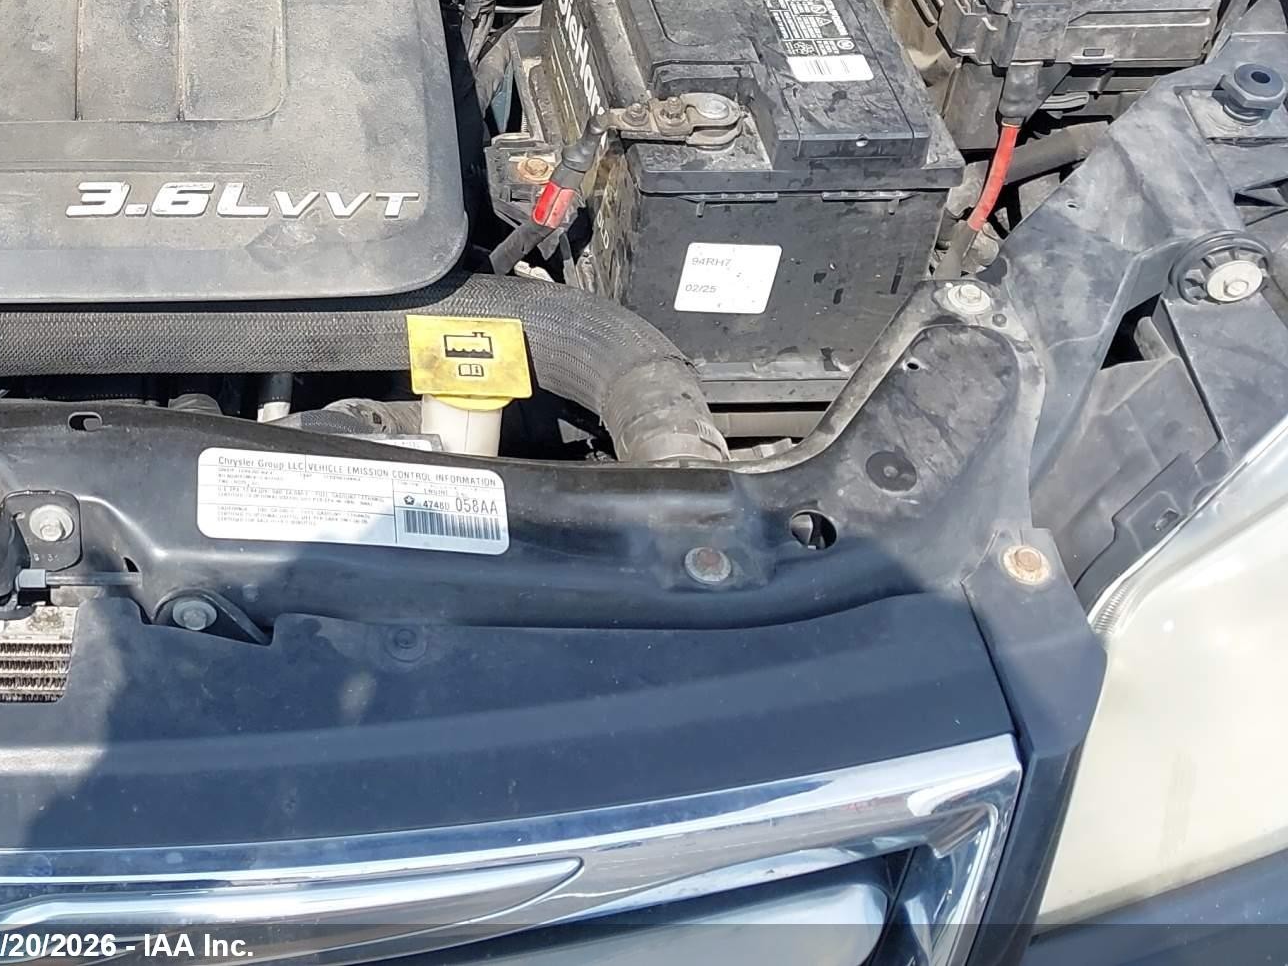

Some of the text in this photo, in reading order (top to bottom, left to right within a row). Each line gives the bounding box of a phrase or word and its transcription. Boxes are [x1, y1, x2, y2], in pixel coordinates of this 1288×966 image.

[273, 191, 420, 220] VVT
[685, 283, 717, 294] 02/25
[218, 456, 304, 471] Chrysler Group LLC
[308, 462, 343, 473] VEHICLE
[347, 466, 389, 477] EMISSION
[392, 470, 431, 481] CONTROL
[436, 473, 496, 487] INFORMATION
